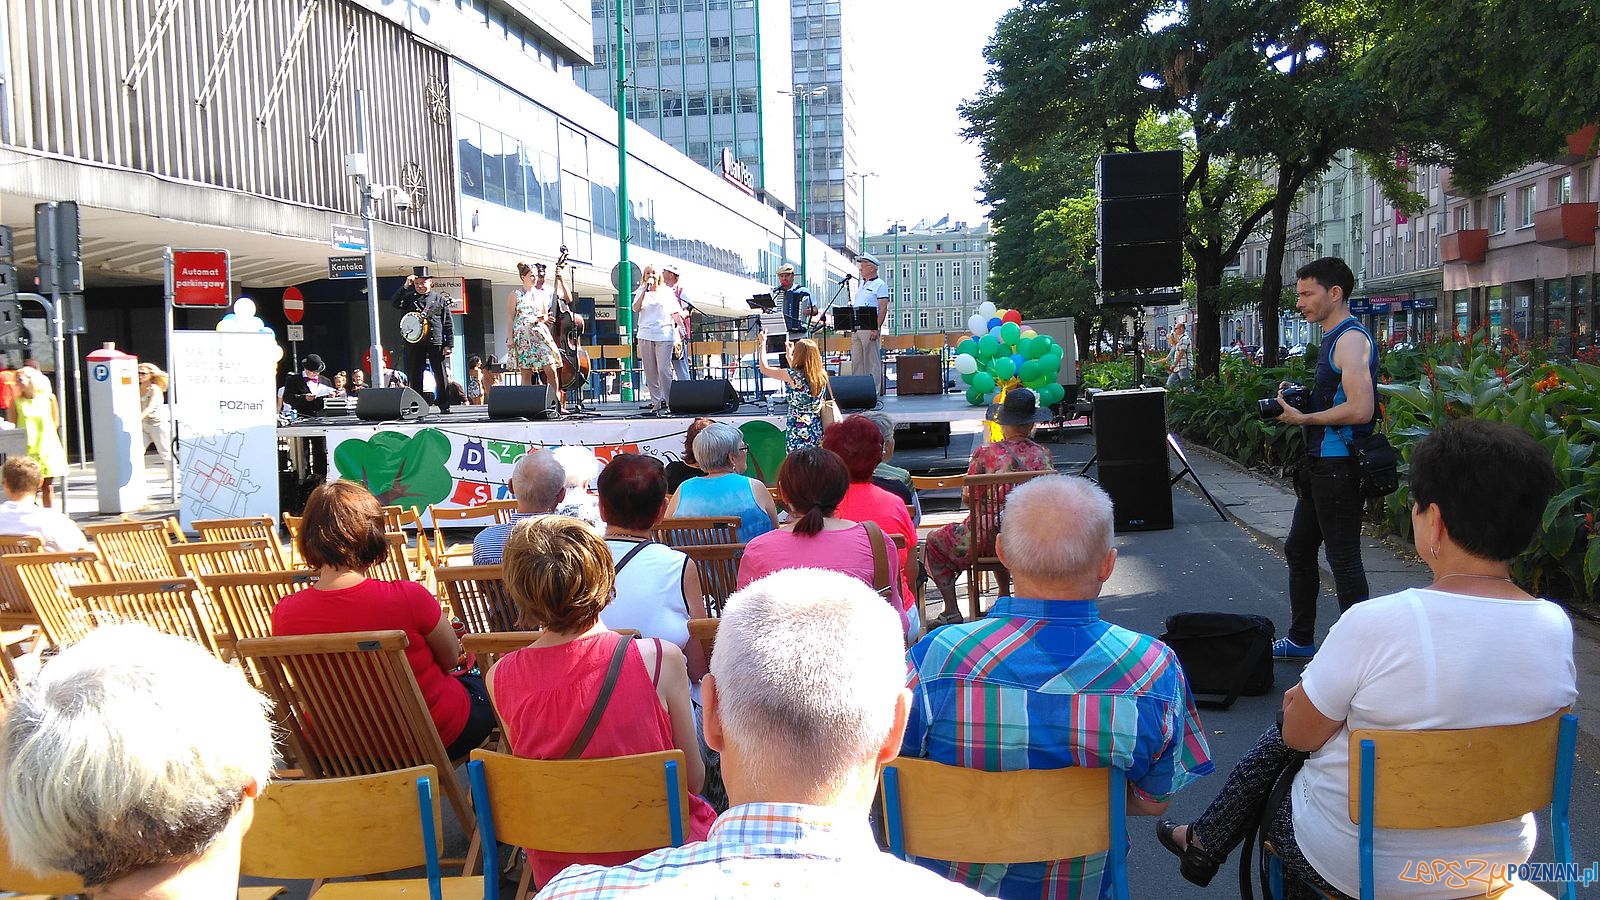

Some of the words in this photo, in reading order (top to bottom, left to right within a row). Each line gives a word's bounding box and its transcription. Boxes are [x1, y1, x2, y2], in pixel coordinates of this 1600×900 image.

[331, 263, 363, 271] Kantaka
[181, 268, 219, 276] Automat
[176, 279, 225, 289] parkingowy
